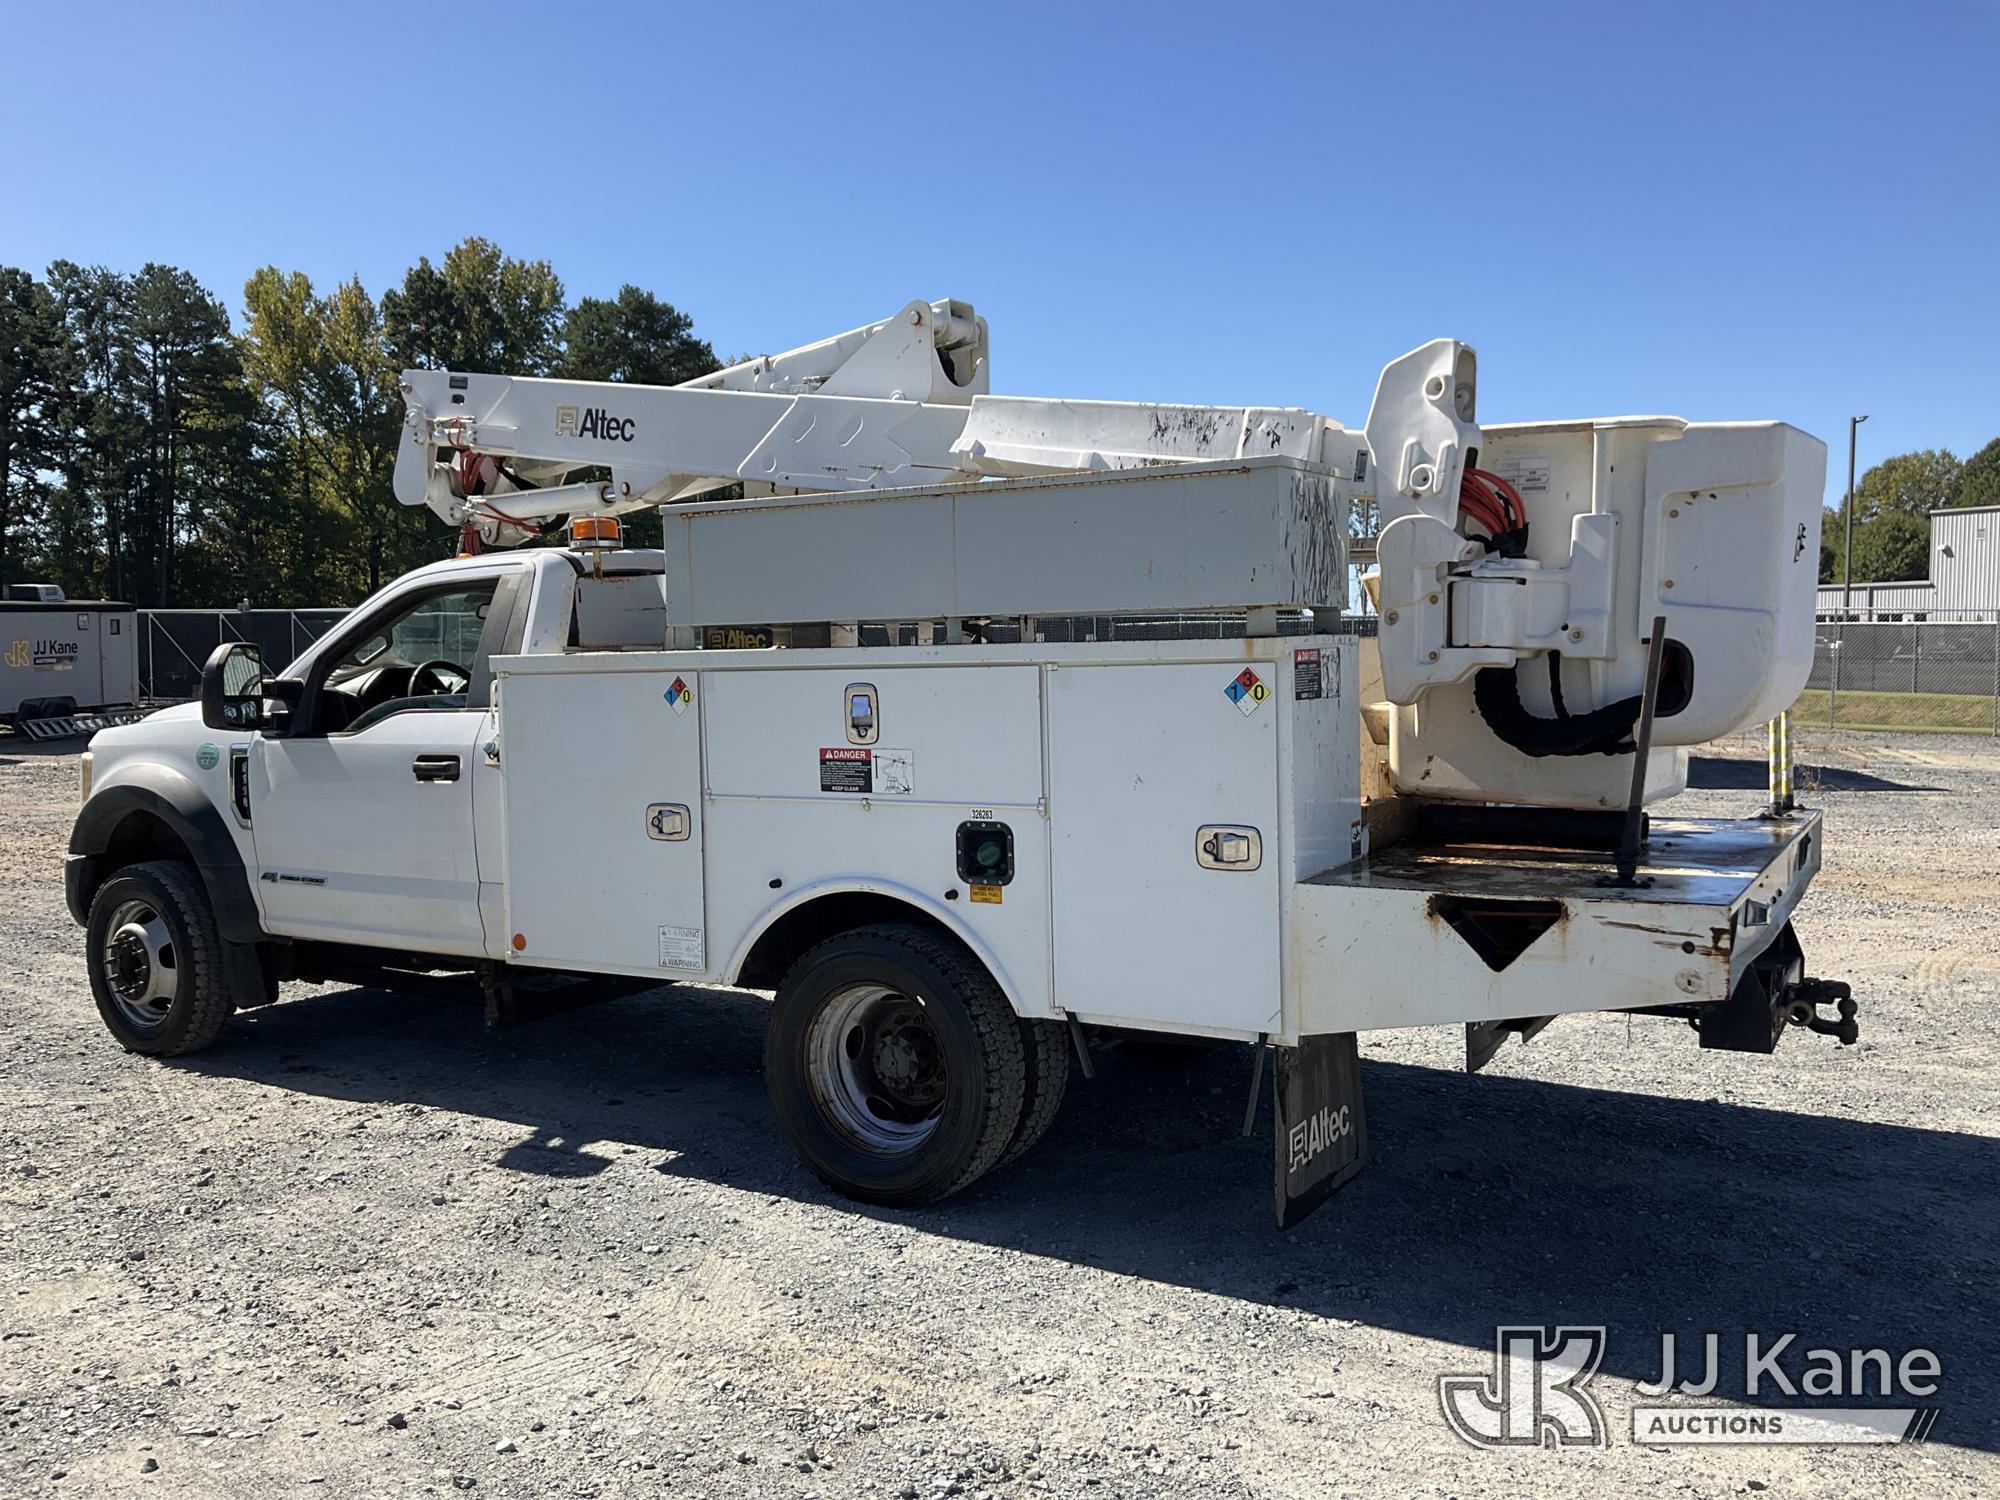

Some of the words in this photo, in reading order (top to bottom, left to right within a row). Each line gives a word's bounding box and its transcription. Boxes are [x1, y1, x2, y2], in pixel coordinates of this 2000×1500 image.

[578, 408, 636, 442] Altec
[726, 629, 767, 648] Altec
[33, 640, 46, 655] JJ
[49, 640, 78, 654] Kane
[1242, 671, 1253, 688] 3
[667, 690, 673, 703] 1
[683, 689, 690, 703] 0
[1230, 684, 1238, 700] 1
[1254, 684, 1265, 701] 0
[833, 750, 866, 759] DANGER
[972, 809, 993, 819] 326263
[1308, 1105, 1350, 1160] Altec
